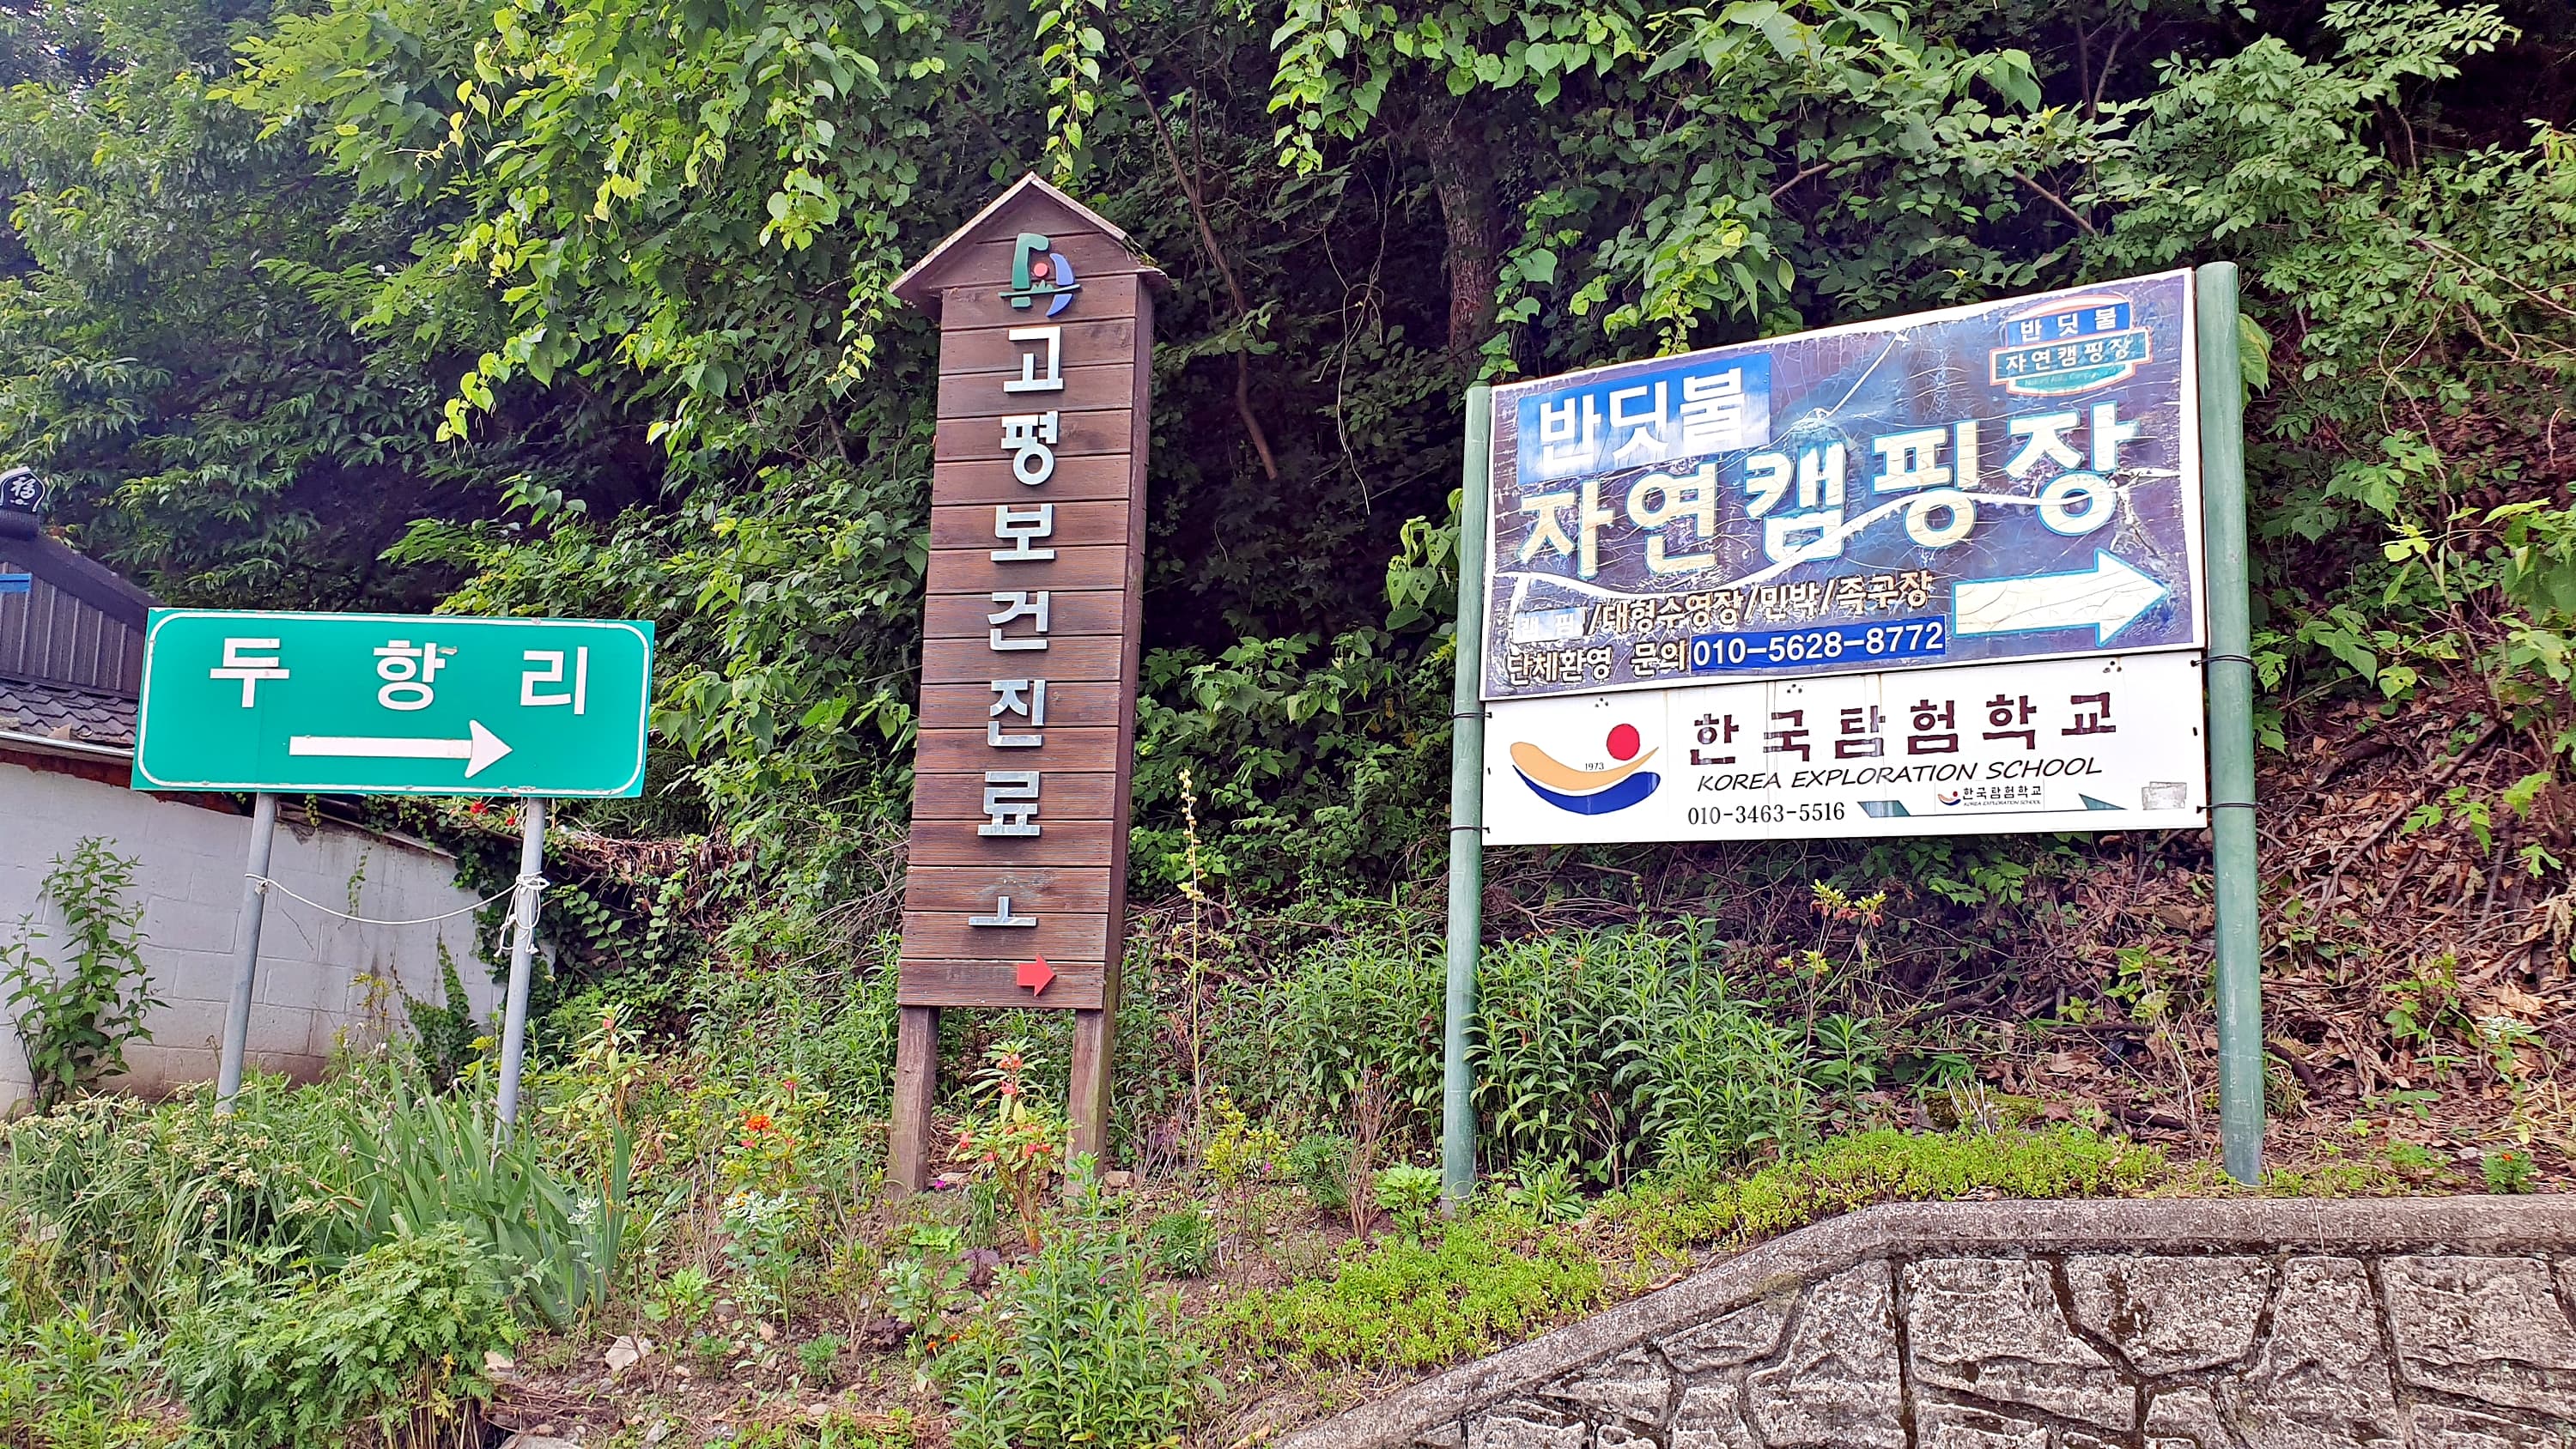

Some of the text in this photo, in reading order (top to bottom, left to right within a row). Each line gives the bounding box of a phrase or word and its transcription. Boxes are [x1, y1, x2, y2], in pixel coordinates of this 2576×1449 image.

[2020, 306, 2117, 343] 반딧불
[2005, 336, 2131, 373] 자연캠핑장
[1538, 374, 1745, 470] 반딧불
[1518, 402, 2140, 578] 자연캠핑장
[210, 637, 588, 714] 두항리
[1509, 622, 1944, 686] 단체환영 문의 010-5628-8772
[1690, 692, 2116, 766] 한국탐험학교
[1697, 756, 2103, 791] KOREA EXPLORATION SCHOOL
[1962, 785, 2041, 800] 한국탐험학교
[1688, 802, 1845, 825] 010-3463-5516
